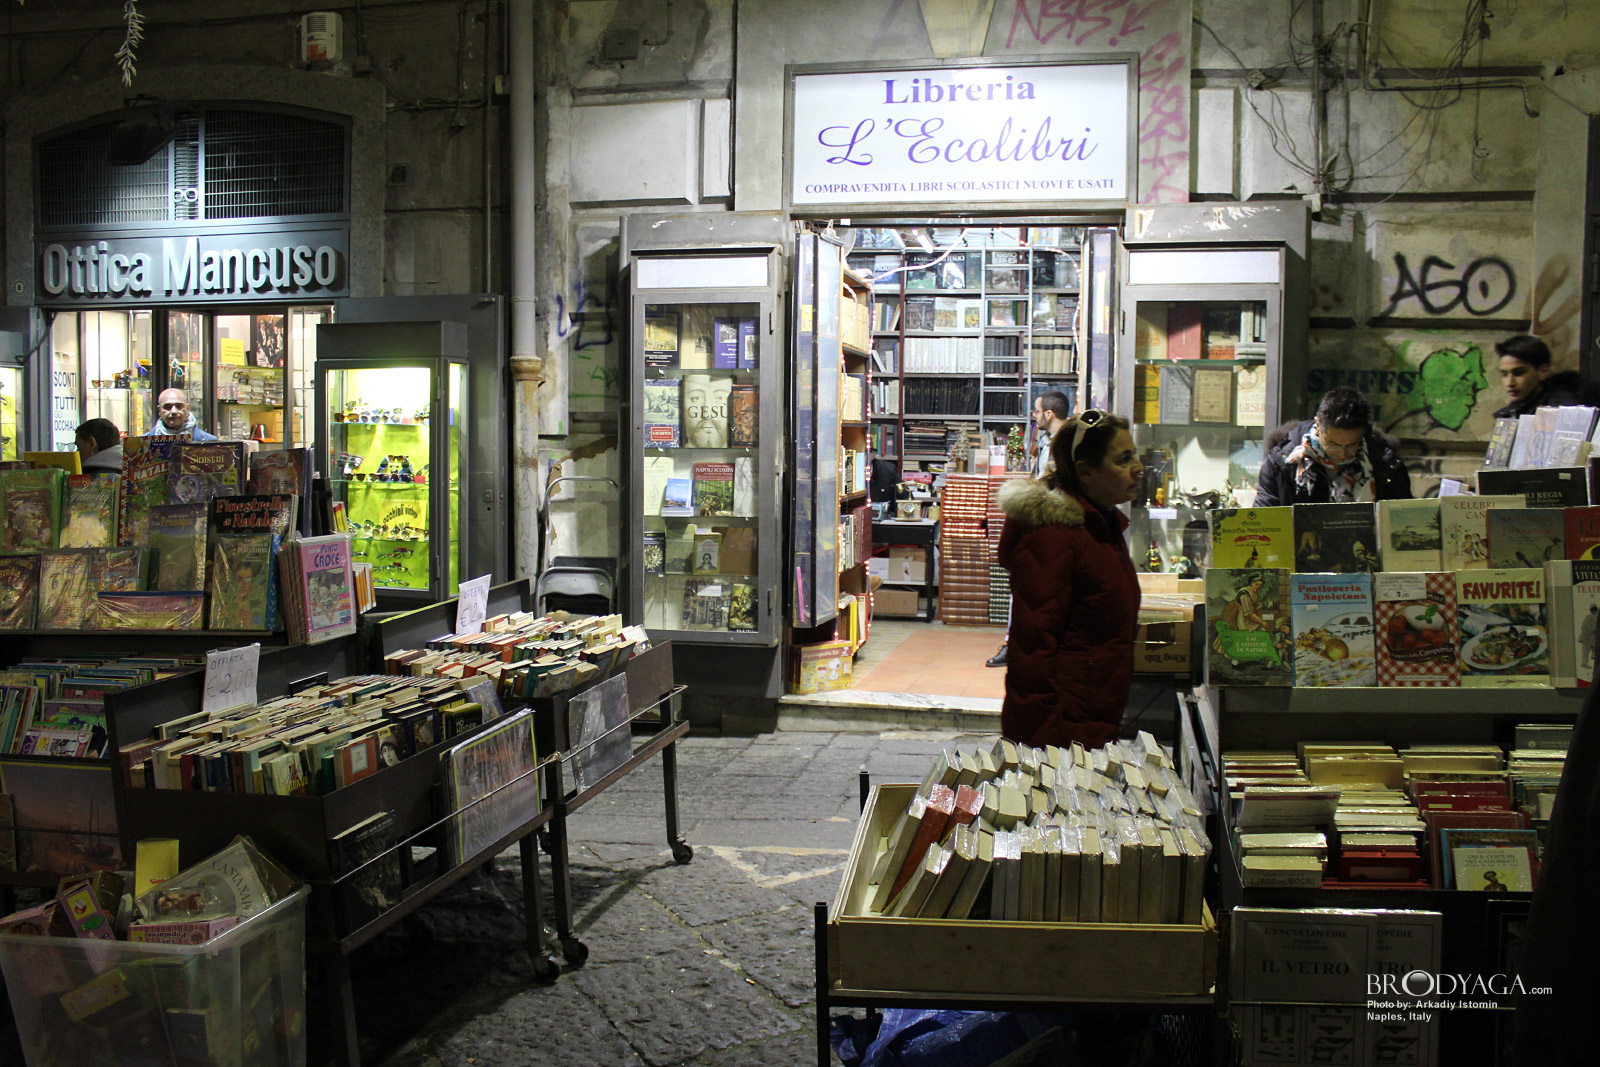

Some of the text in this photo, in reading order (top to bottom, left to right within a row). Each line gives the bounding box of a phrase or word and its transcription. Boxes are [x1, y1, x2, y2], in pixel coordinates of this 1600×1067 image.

[882, 75, 1036, 105] Libreria
[817, 116, 1101, 167] L'Ecolibri
[805, 179, 1114, 194] COMPRAVENDITA LIBRI SCOLASTICI NUOVI E USATI
[42, 236, 343, 296] Ottica Mancuso
[54, 371, 77, 387] SCONTI
[54, 396, 77, 410] TUTTI
[1454, 501, 1496, 510] CELEBRI
[314, 554, 340, 568] CROCE
[1462, 581, 1541, 600] FAVURITE!
[1262, 960, 1350, 976] IL VETRO
